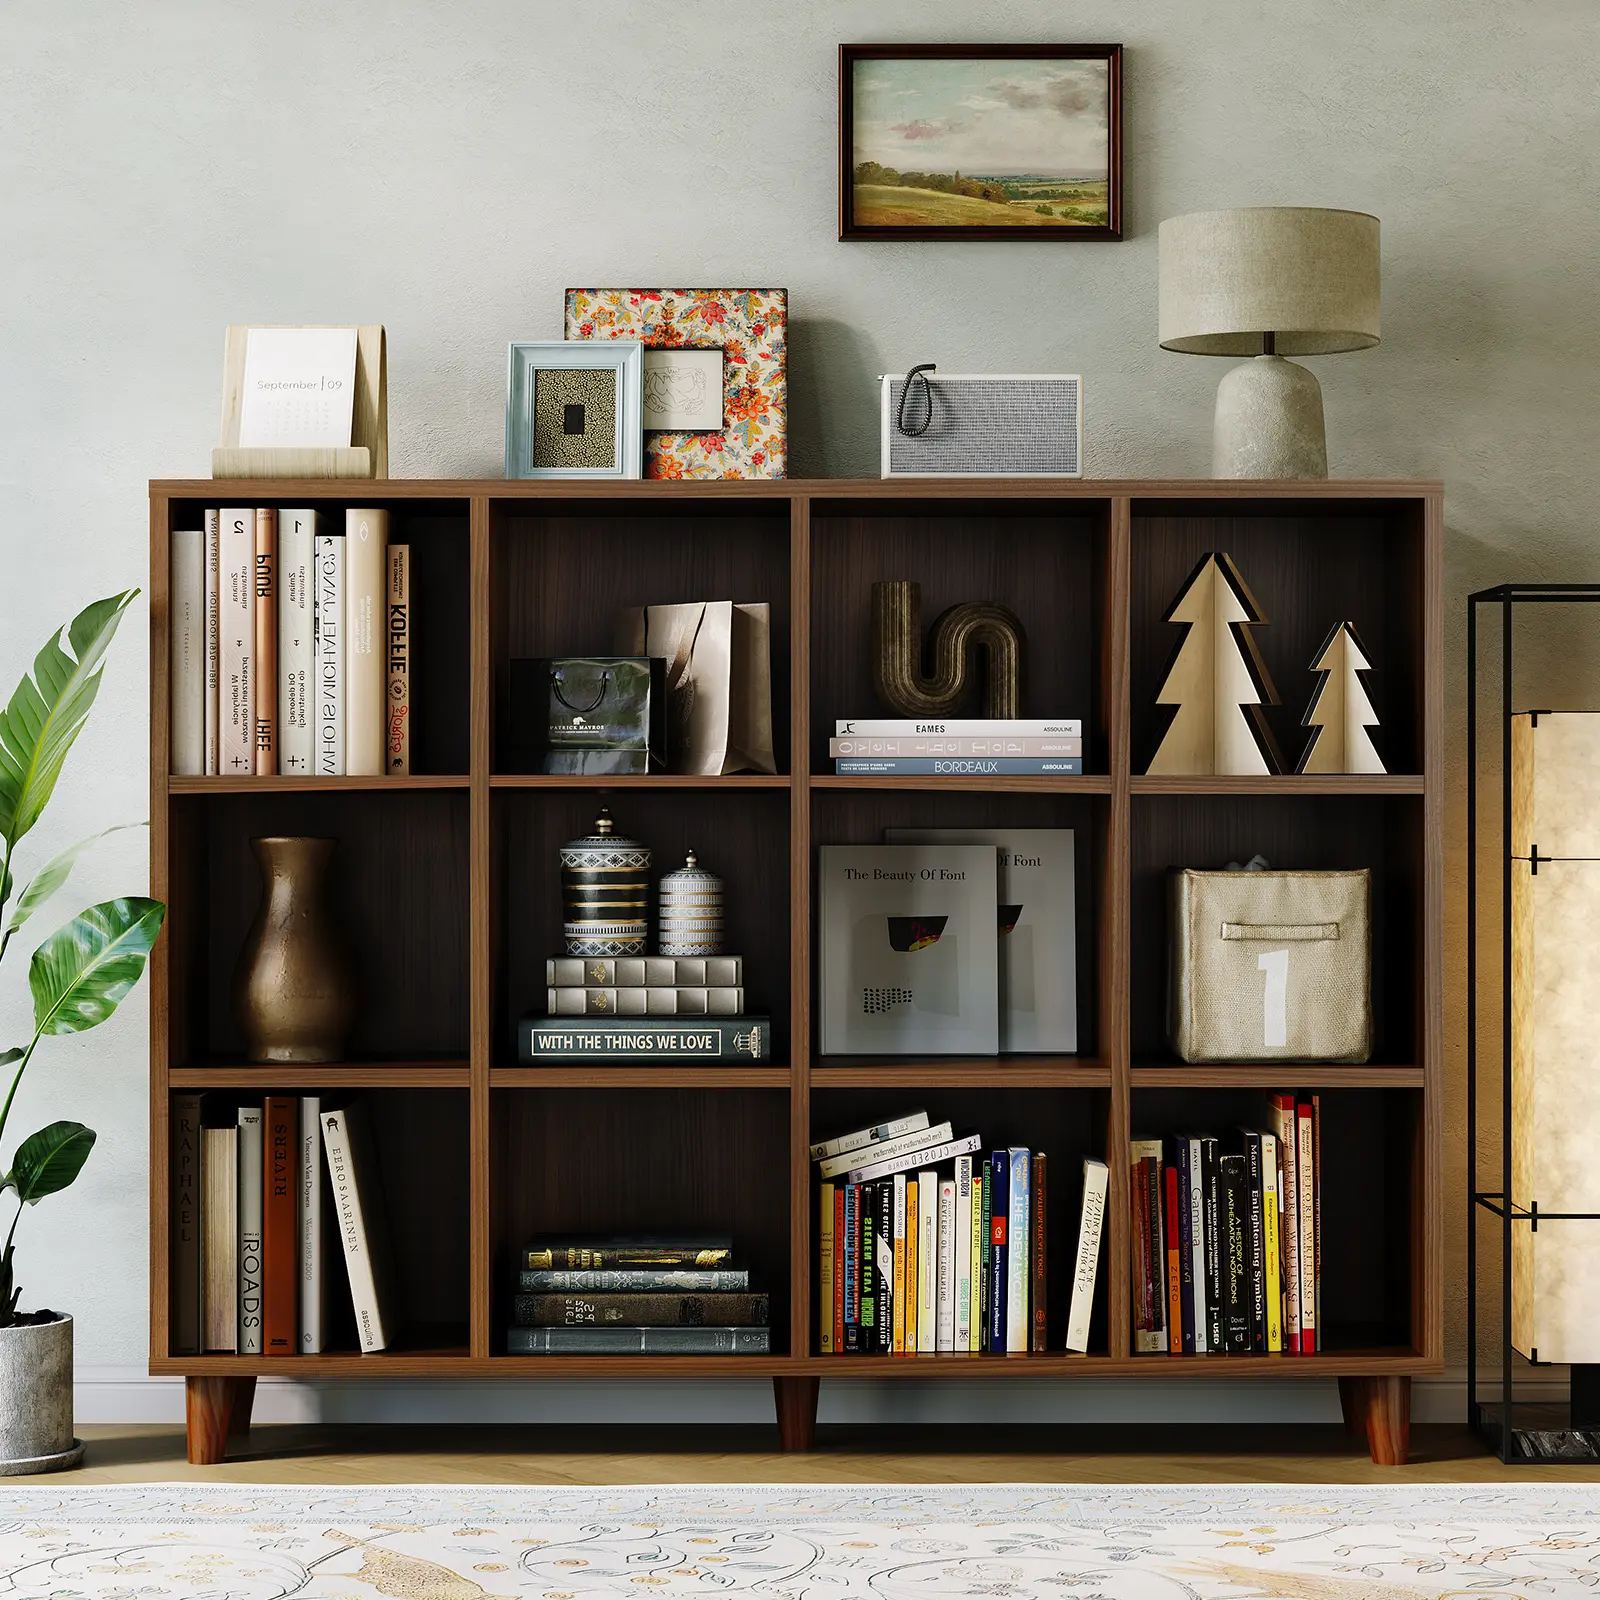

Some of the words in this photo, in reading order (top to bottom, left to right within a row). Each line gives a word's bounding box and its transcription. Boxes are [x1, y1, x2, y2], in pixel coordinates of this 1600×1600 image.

[257, 380, 317, 391] September
[327, 380, 342, 390] 09
[916, 724, 945, 733] EAMES
[934, 761, 998, 773] BORDEAUX
[845, 869, 868, 880] The
[873, 869, 916, 882] Beauty
[920, 869, 936, 880] Of
[940, 870, 966, 880] Font
[1014, 855, 1042, 867] Font
[1258, 949, 1289, 1046] 1
[538, 1035, 572, 1050] WITH
[576, 1035, 600, 1050] THE
[605, 1035, 652, 1050] THINGS
[657, 1035, 676, 1050] WE
[680, 1035, 712, 1050] LOVE
[274, 1124, 287, 1197] RIVERS
[179, 1118, 192, 1242] RAPHAEL
[304, 1181, 312, 1208] Duysen
[332, 1148, 346, 1182] EERO
[339, 1185, 358, 1252] SAARINEN
[1192, 1188, 1202, 1246] Gamma
[1228, 1188, 1236, 1254] MATHEMATICAL
[1236, 1216, 1242, 1224] A
[1251, 1190, 1260, 1267] Enlightening
[243, 1240, 260, 1328] ROADS
[1170, 1266, 1178, 1302] ZERO
[1184, 1262, 1190, 1270] of
[1230, 1256, 1238, 1304] NOTATIONS
[1237, 1264, 1244, 1276] OF
[1253, 1270, 1262, 1321] Symbols
[361, 1310, 374, 1346] assouline
